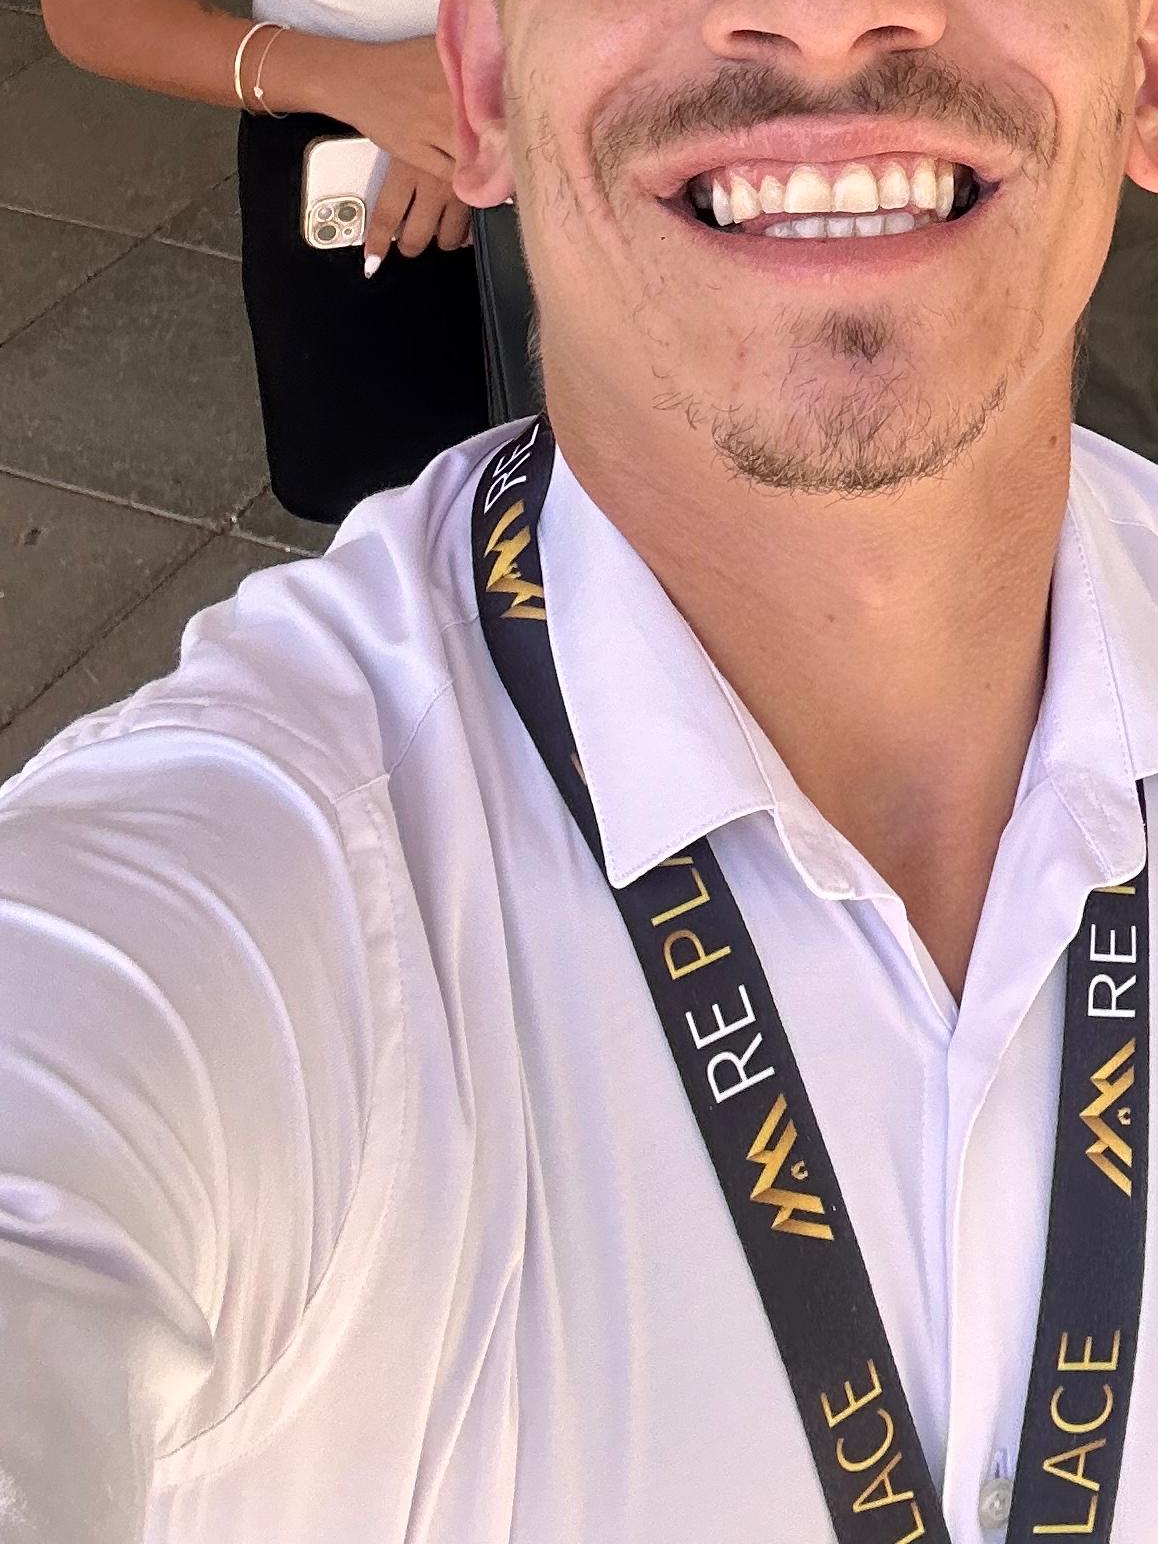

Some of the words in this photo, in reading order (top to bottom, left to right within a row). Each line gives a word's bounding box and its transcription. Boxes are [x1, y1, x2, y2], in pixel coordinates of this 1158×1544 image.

[484, 423, 540, 515] RE
[651, 856, 732, 980] PL
[1087, 923, 1137, 1018] RE
[685, 983, 776, 1104] RE
[1033, 1329, 1121, 1535] LACE
